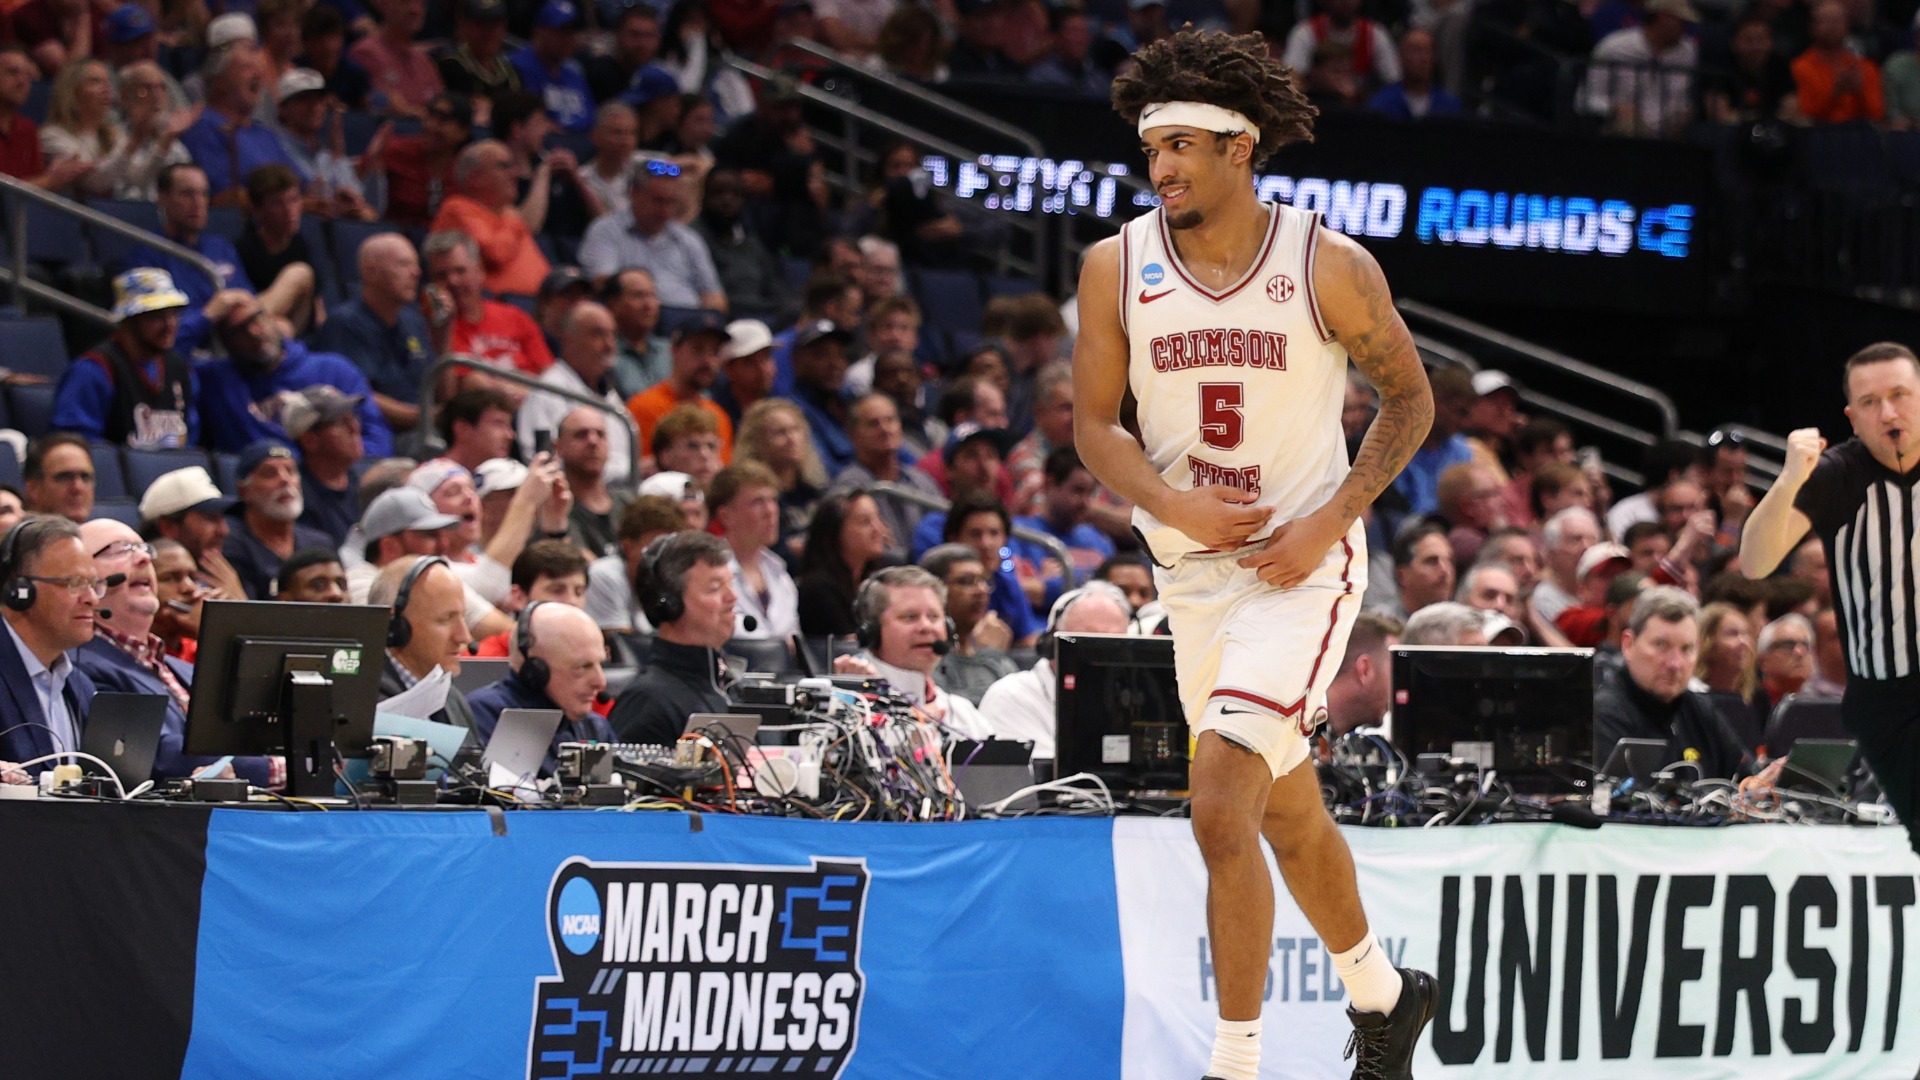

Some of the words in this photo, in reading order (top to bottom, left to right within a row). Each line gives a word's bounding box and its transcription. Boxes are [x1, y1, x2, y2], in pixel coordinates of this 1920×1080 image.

[1415, 186, 1636, 256] ROUNDS
[1267, 275, 1293, 302] SEC
[1150, 329, 1287, 372] CRIMSON
[1198, 382, 1244, 451] 5
[1187, 454, 1261, 505] TIDE
[562, 914, 600, 935] NCAA
[602, 882, 774, 963] MARCH
[1198, 937, 1346, 1001] HTED
[1431, 874, 1920, 1065] UNIVERSIT
[620, 971, 855, 1051] MADNESS
